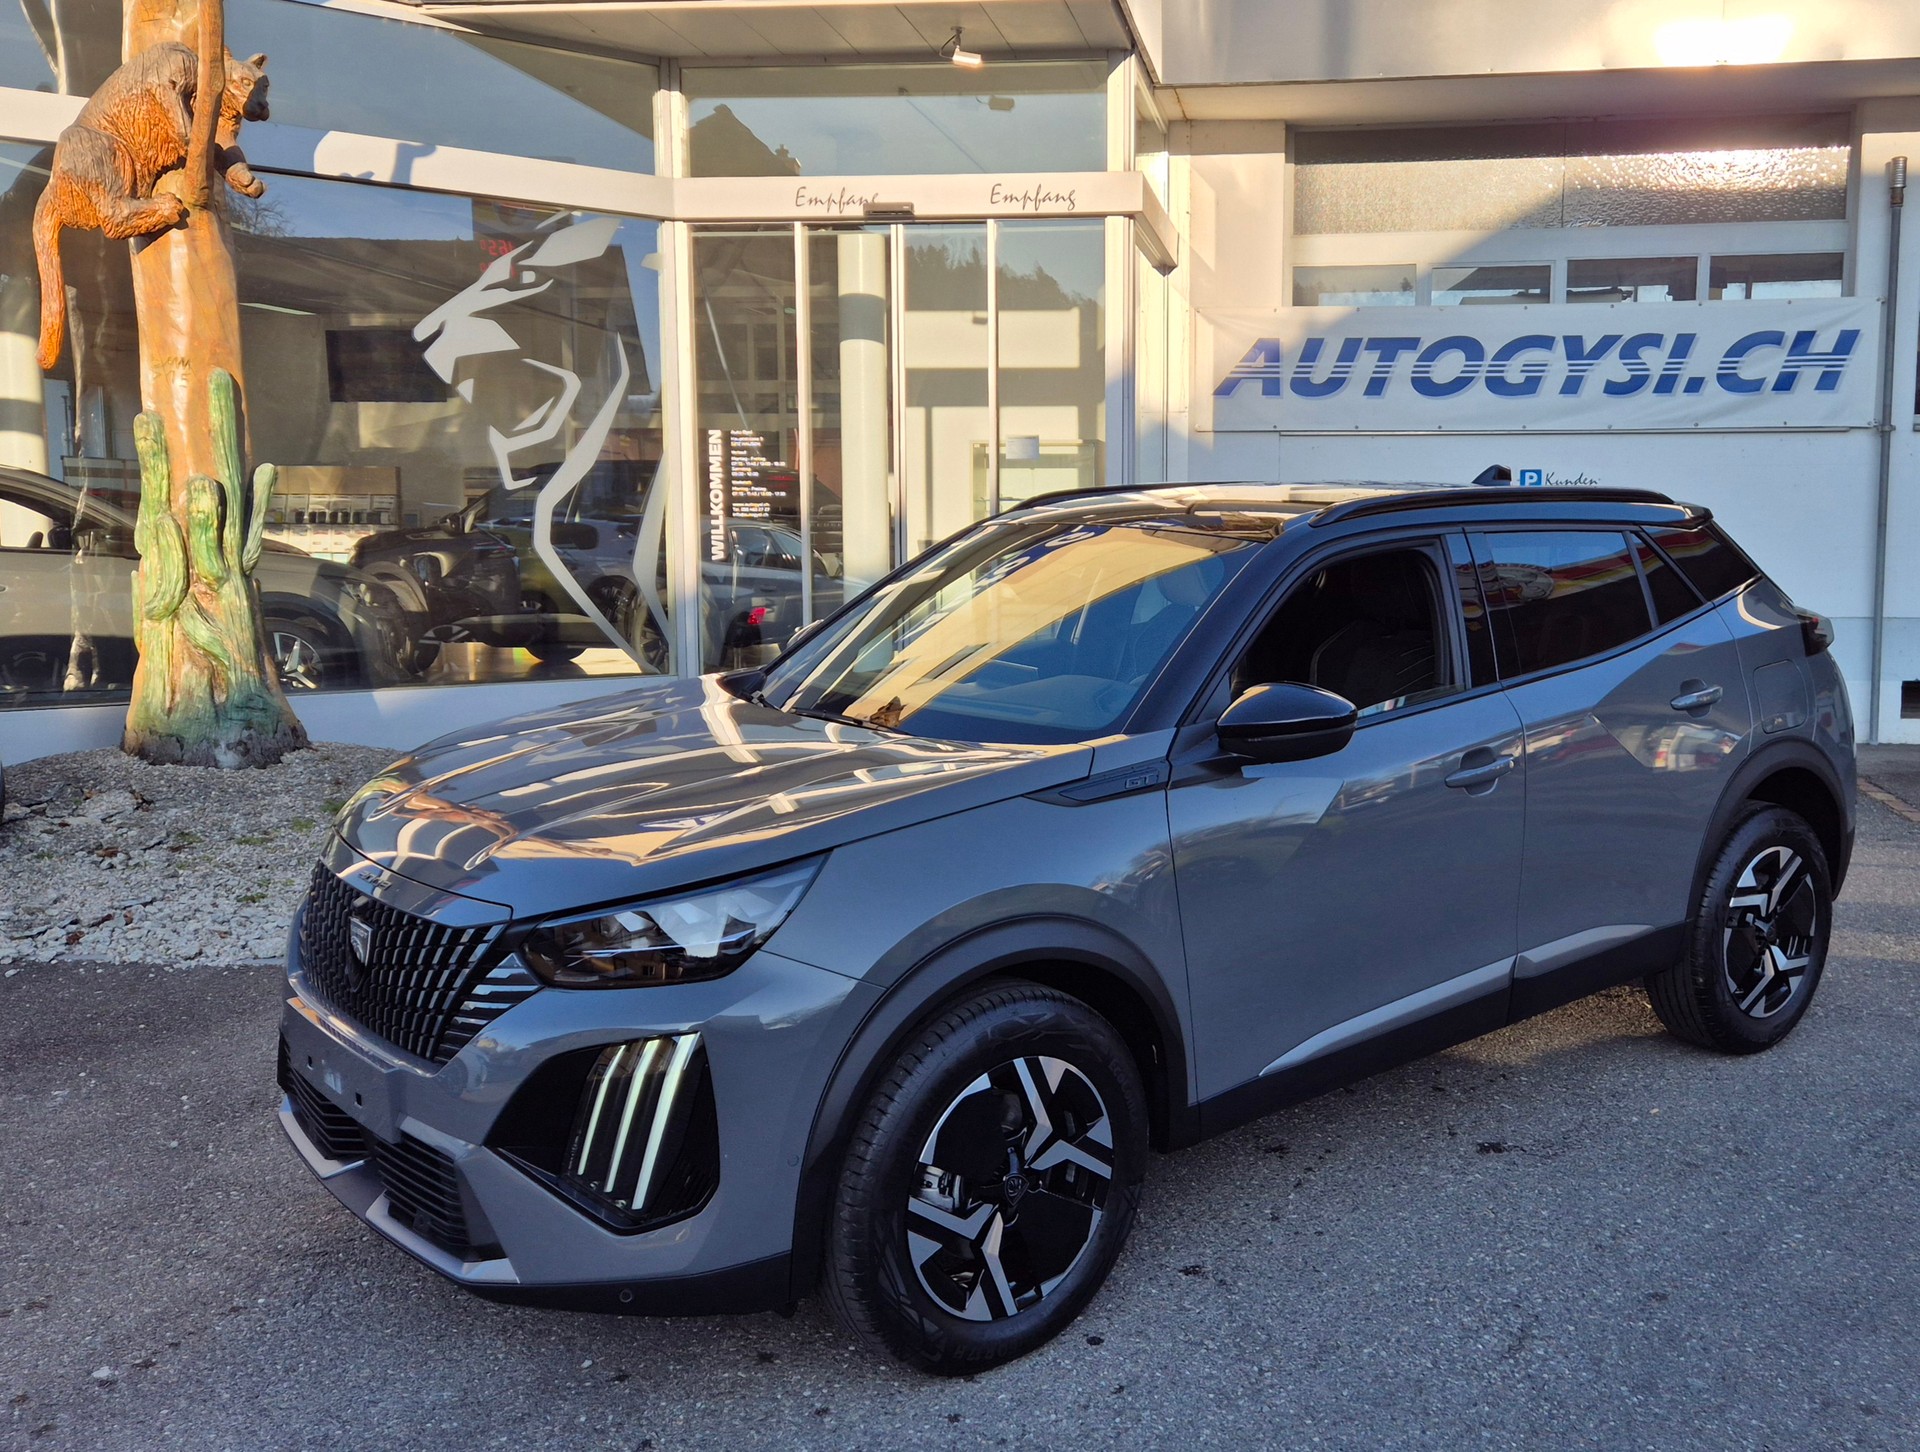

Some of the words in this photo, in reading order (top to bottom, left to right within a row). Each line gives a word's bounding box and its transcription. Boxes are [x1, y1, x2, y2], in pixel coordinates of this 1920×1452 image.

[990, 183, 1076, 212] Empfang
[1213, 329, 1861, 399] AUTOGYSI.CH
[708, 429, 724, 560] WILLKOMMEN
[1545, 472, 1598, 486] Kunden
